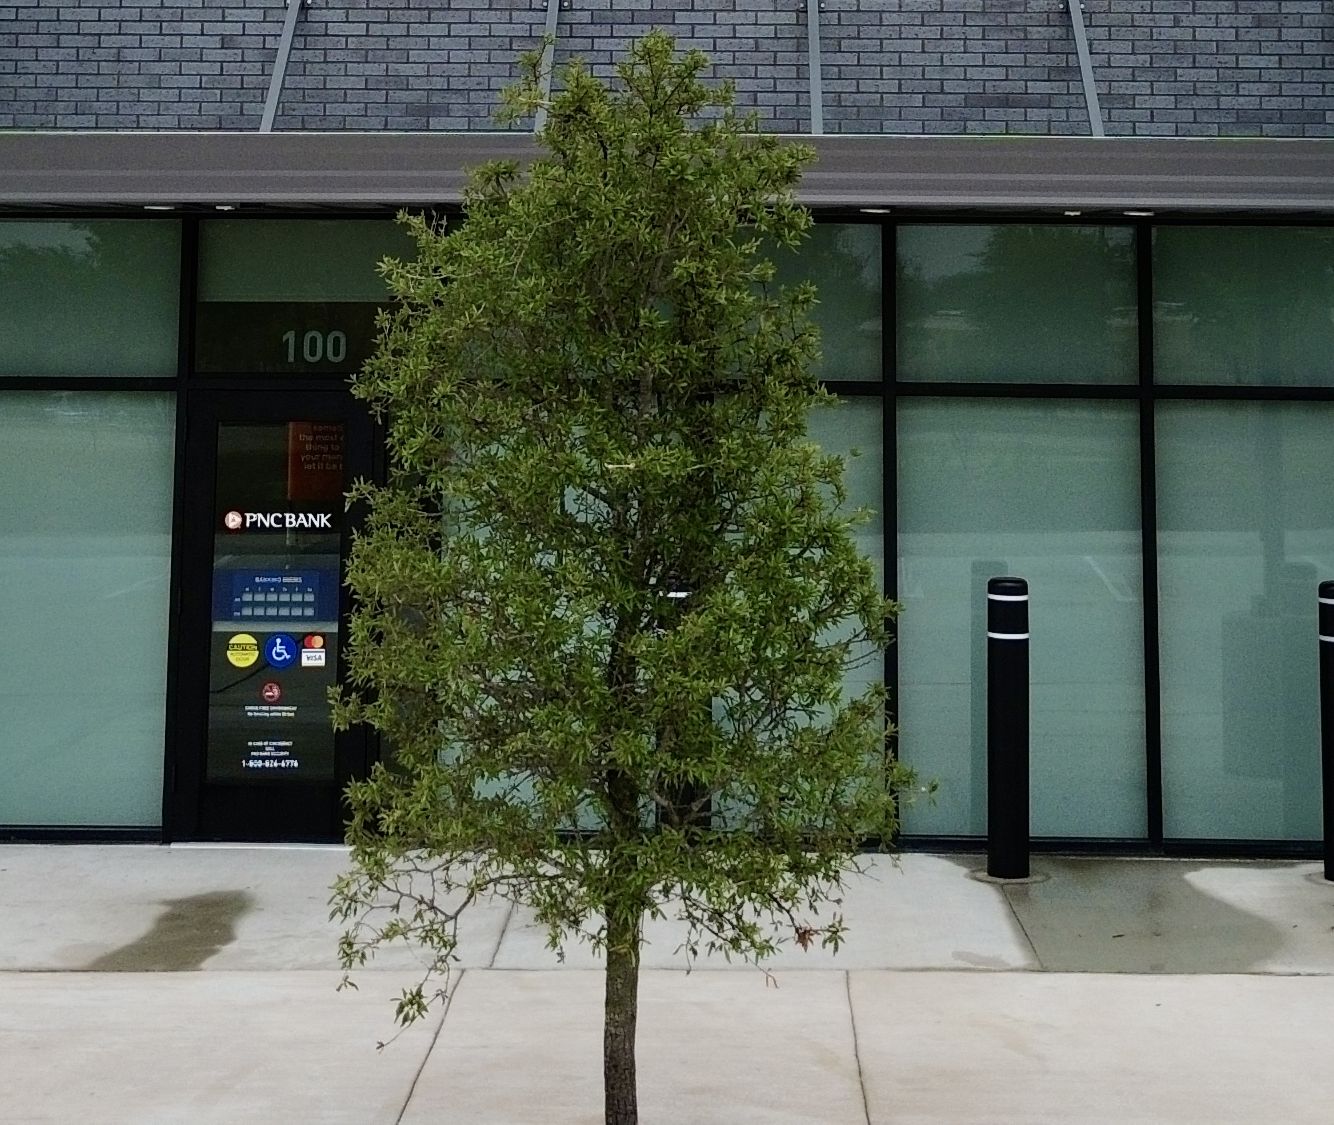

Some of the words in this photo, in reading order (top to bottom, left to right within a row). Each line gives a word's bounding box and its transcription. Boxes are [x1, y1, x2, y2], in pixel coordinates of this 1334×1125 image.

[282, 330, 347, 363] 100
[244, 512, 283, 528] PNC
[284, 512, 332, 528] BANK
